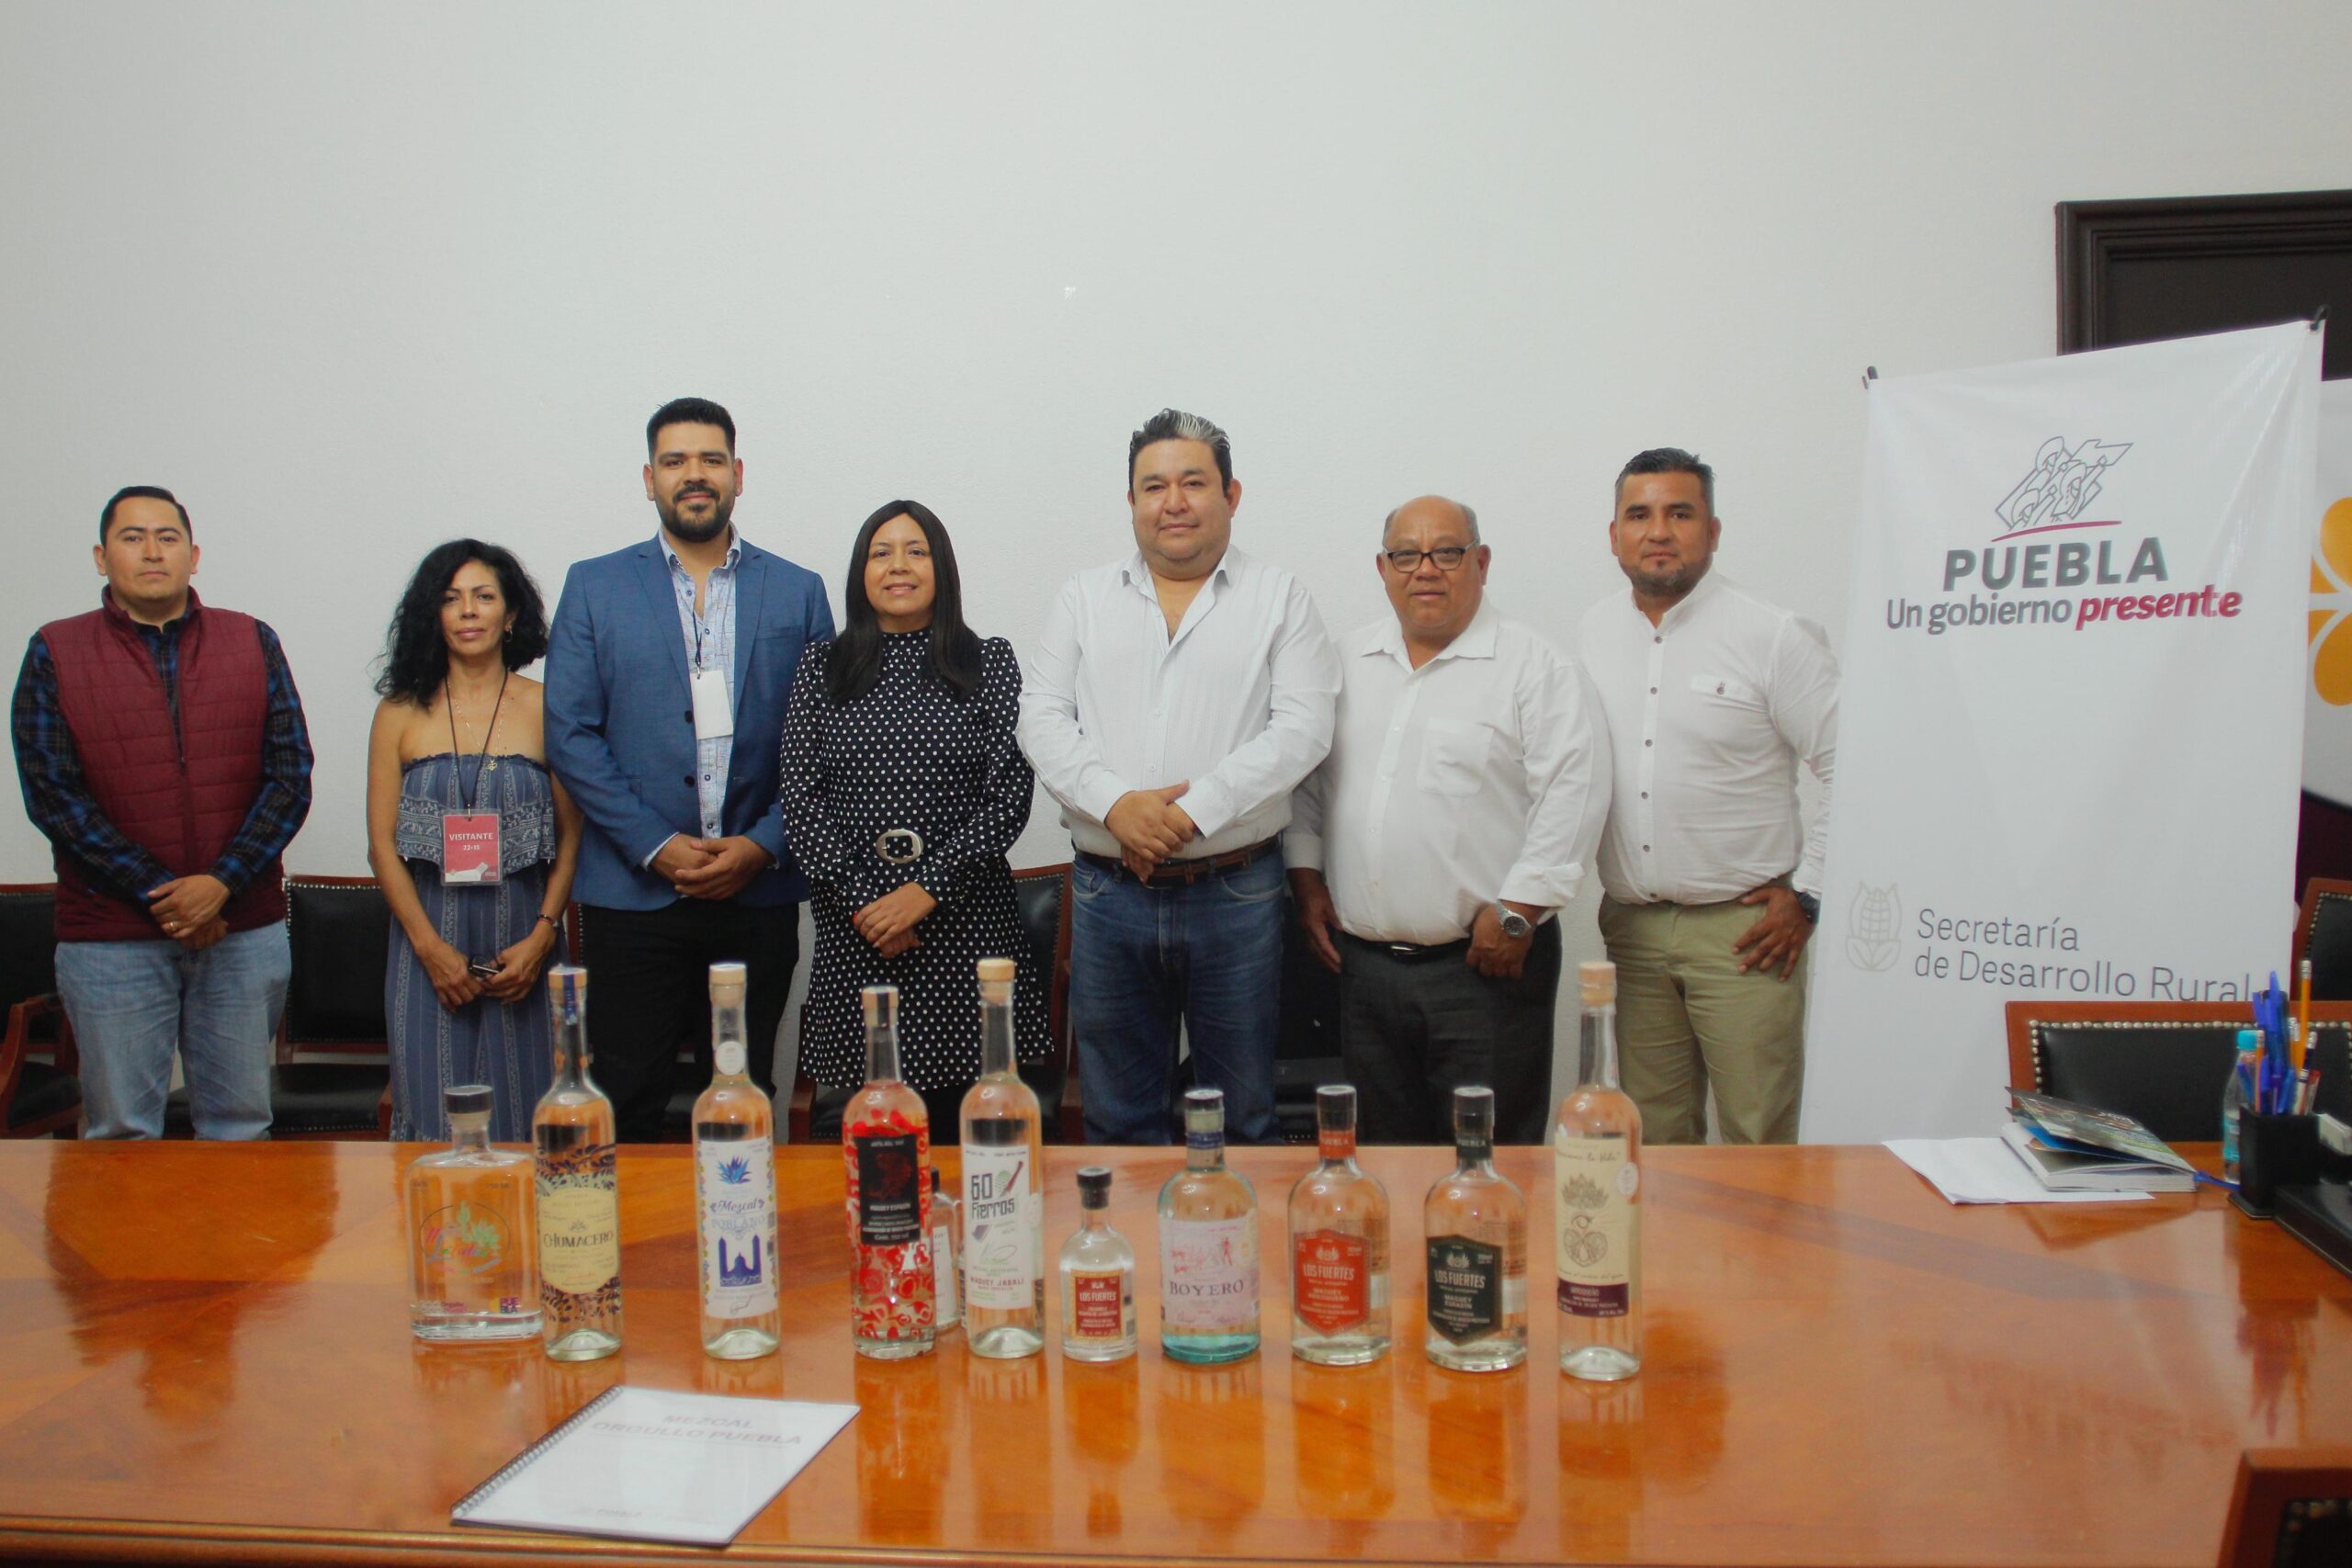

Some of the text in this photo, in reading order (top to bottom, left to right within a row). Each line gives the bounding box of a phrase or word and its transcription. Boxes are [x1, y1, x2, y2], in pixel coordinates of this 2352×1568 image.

[1942, 536, 2169, 592] PUEBLA
[1886, 583, 2244, 636] Un gobierno presente
[448, 832, 493, 840] VISITANTE
[1917, 908, 2081, 953] Secretaría
[1914, 947, 2251, 1002] de Desarrollo Rural
[971, 1172, 993, 1201] 60
[718, 1198, 758, 1213] Mezcal
[972, 1197, 1015, 1220] Fierros
[543, 1231, 615, 1248] CHUMACERO
[1303, 1264, 1356, 1280] LOS FUERTES
[1433, 1269, 1487, 1289] LOS FUERTES
[1080, 1291, 1117, 1302] LOS FUERTES
[1170, 1279, 1244, 1296] BOYERO
[662, 1415, 753, 1428] MEZCAL
[593, 1422, 802, 1445] ORGULLO PUEBLA
